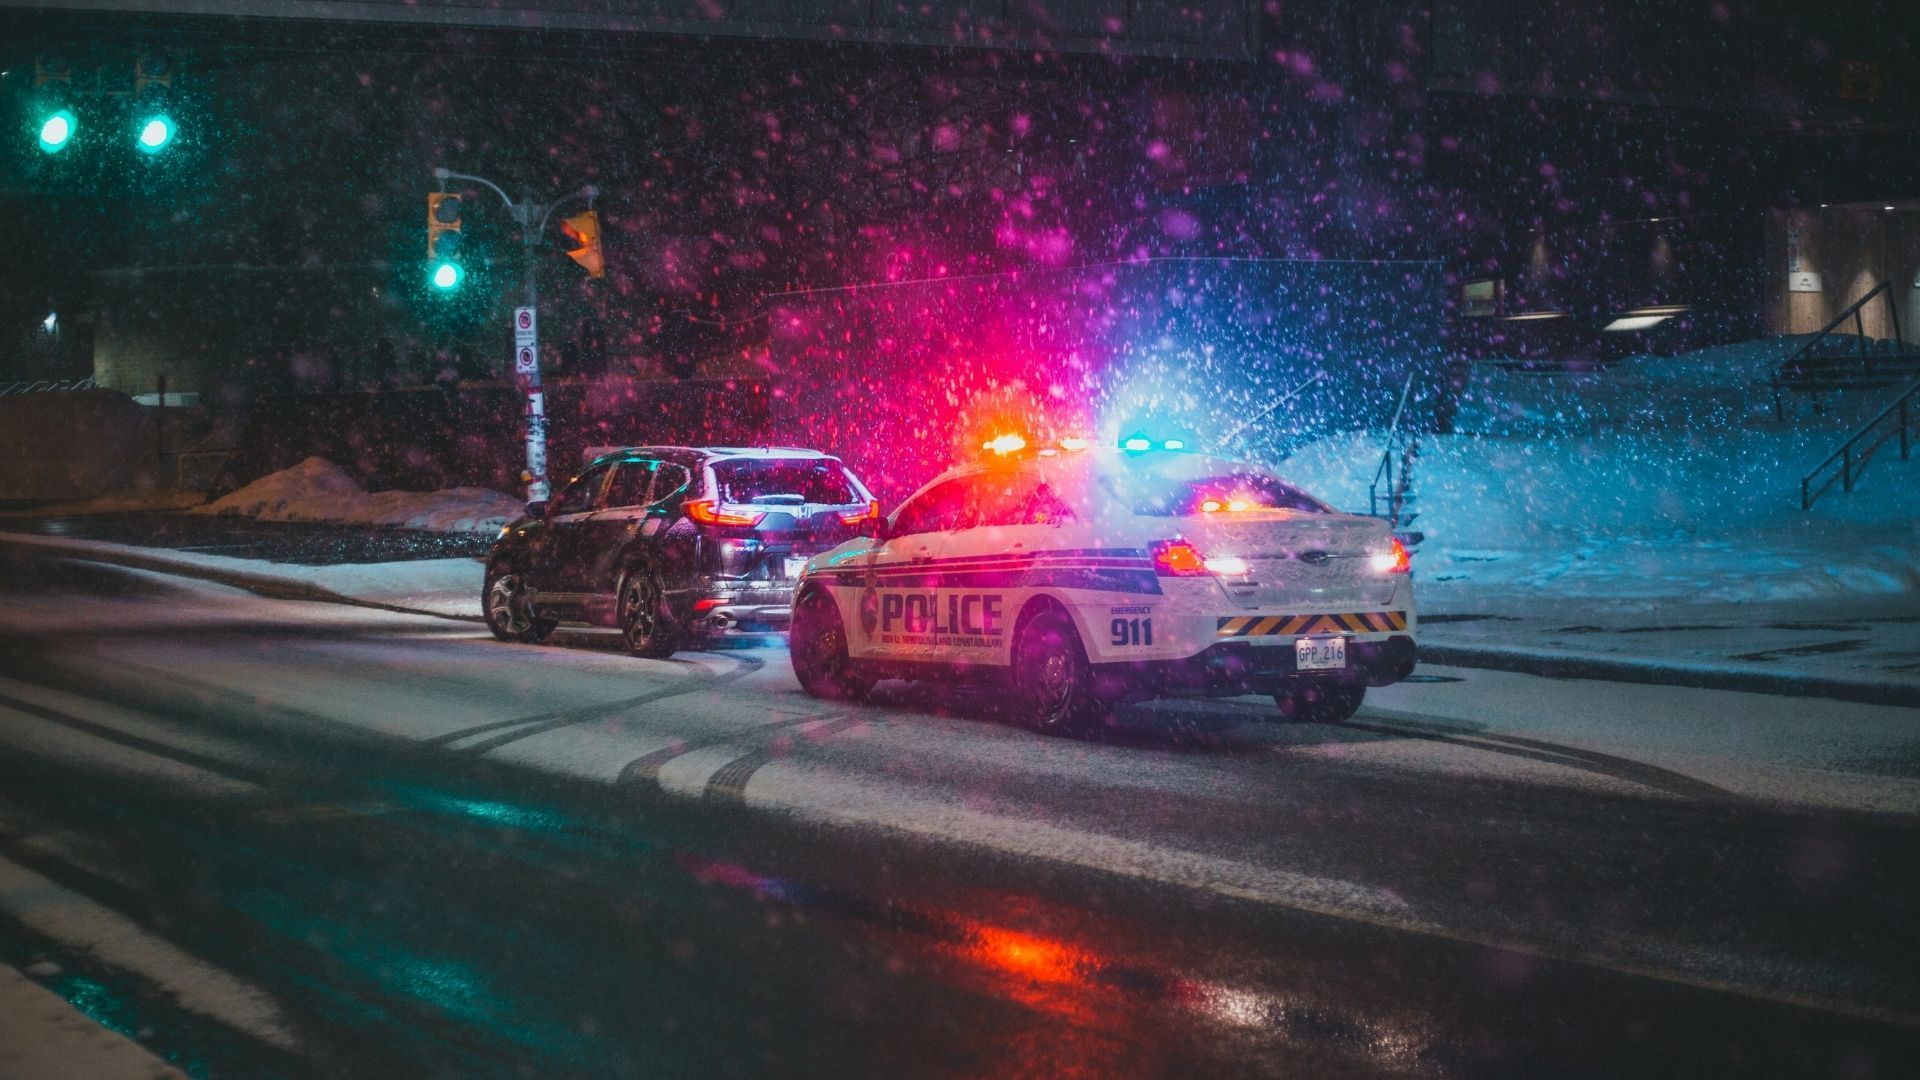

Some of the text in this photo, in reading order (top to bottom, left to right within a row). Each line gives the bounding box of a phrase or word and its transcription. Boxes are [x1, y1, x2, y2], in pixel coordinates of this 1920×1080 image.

[882, 594, 1003, 636] POLICE
[1111, 606, 1152, 615] EMERGENCY
[1111, 617, 1152, 646] 911
[882, 634, 901, 644] ROYAL
[953, 637, 1003, 648] CONSTABULARY
[1299, 646, 1343, 661] GPP 216
